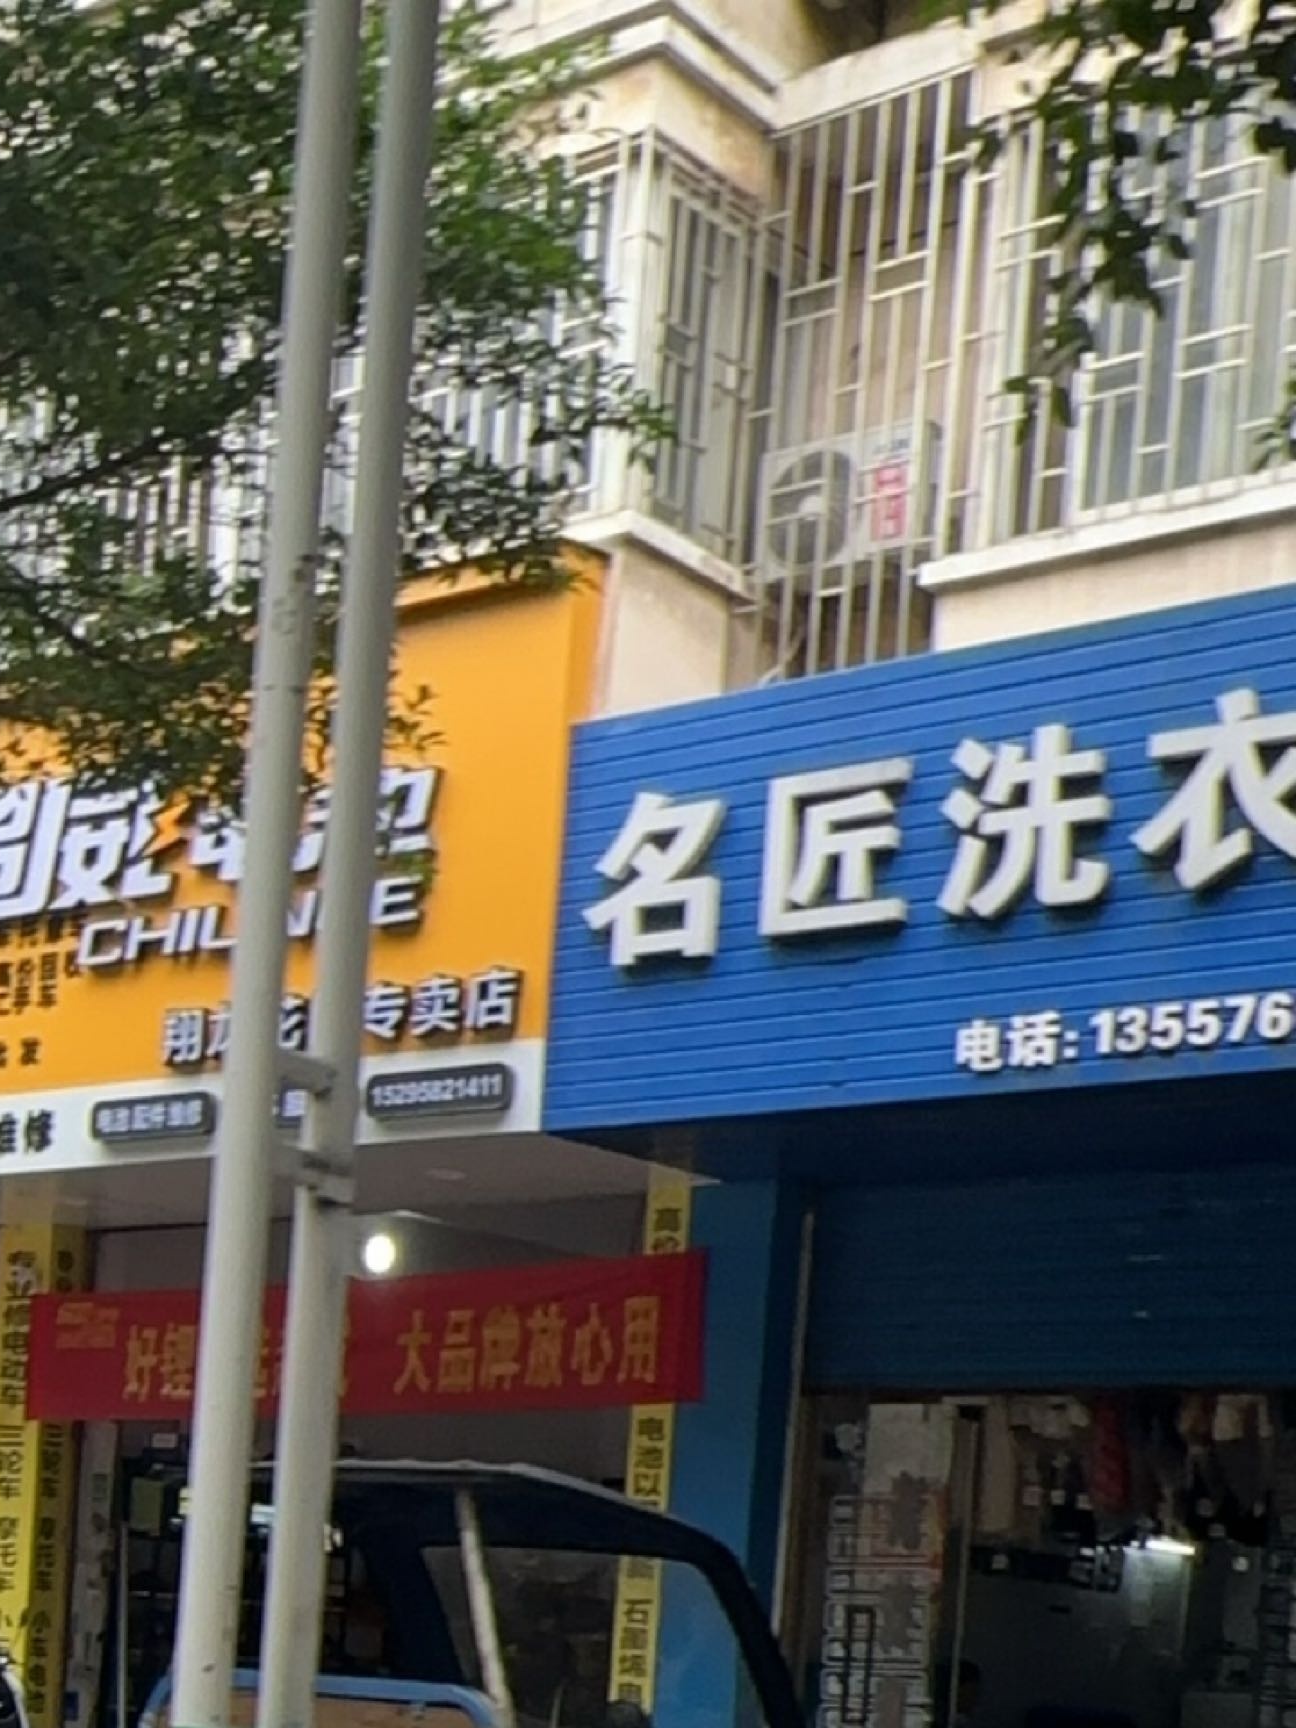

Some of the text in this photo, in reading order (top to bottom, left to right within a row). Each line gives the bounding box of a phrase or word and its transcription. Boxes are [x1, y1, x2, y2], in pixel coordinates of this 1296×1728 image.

[582, 687, 1296, 966] 名匠洗衣
[77, 875, 426, 966] CHILE
[393, 1296, 659, 1394] 大品牌放心用
